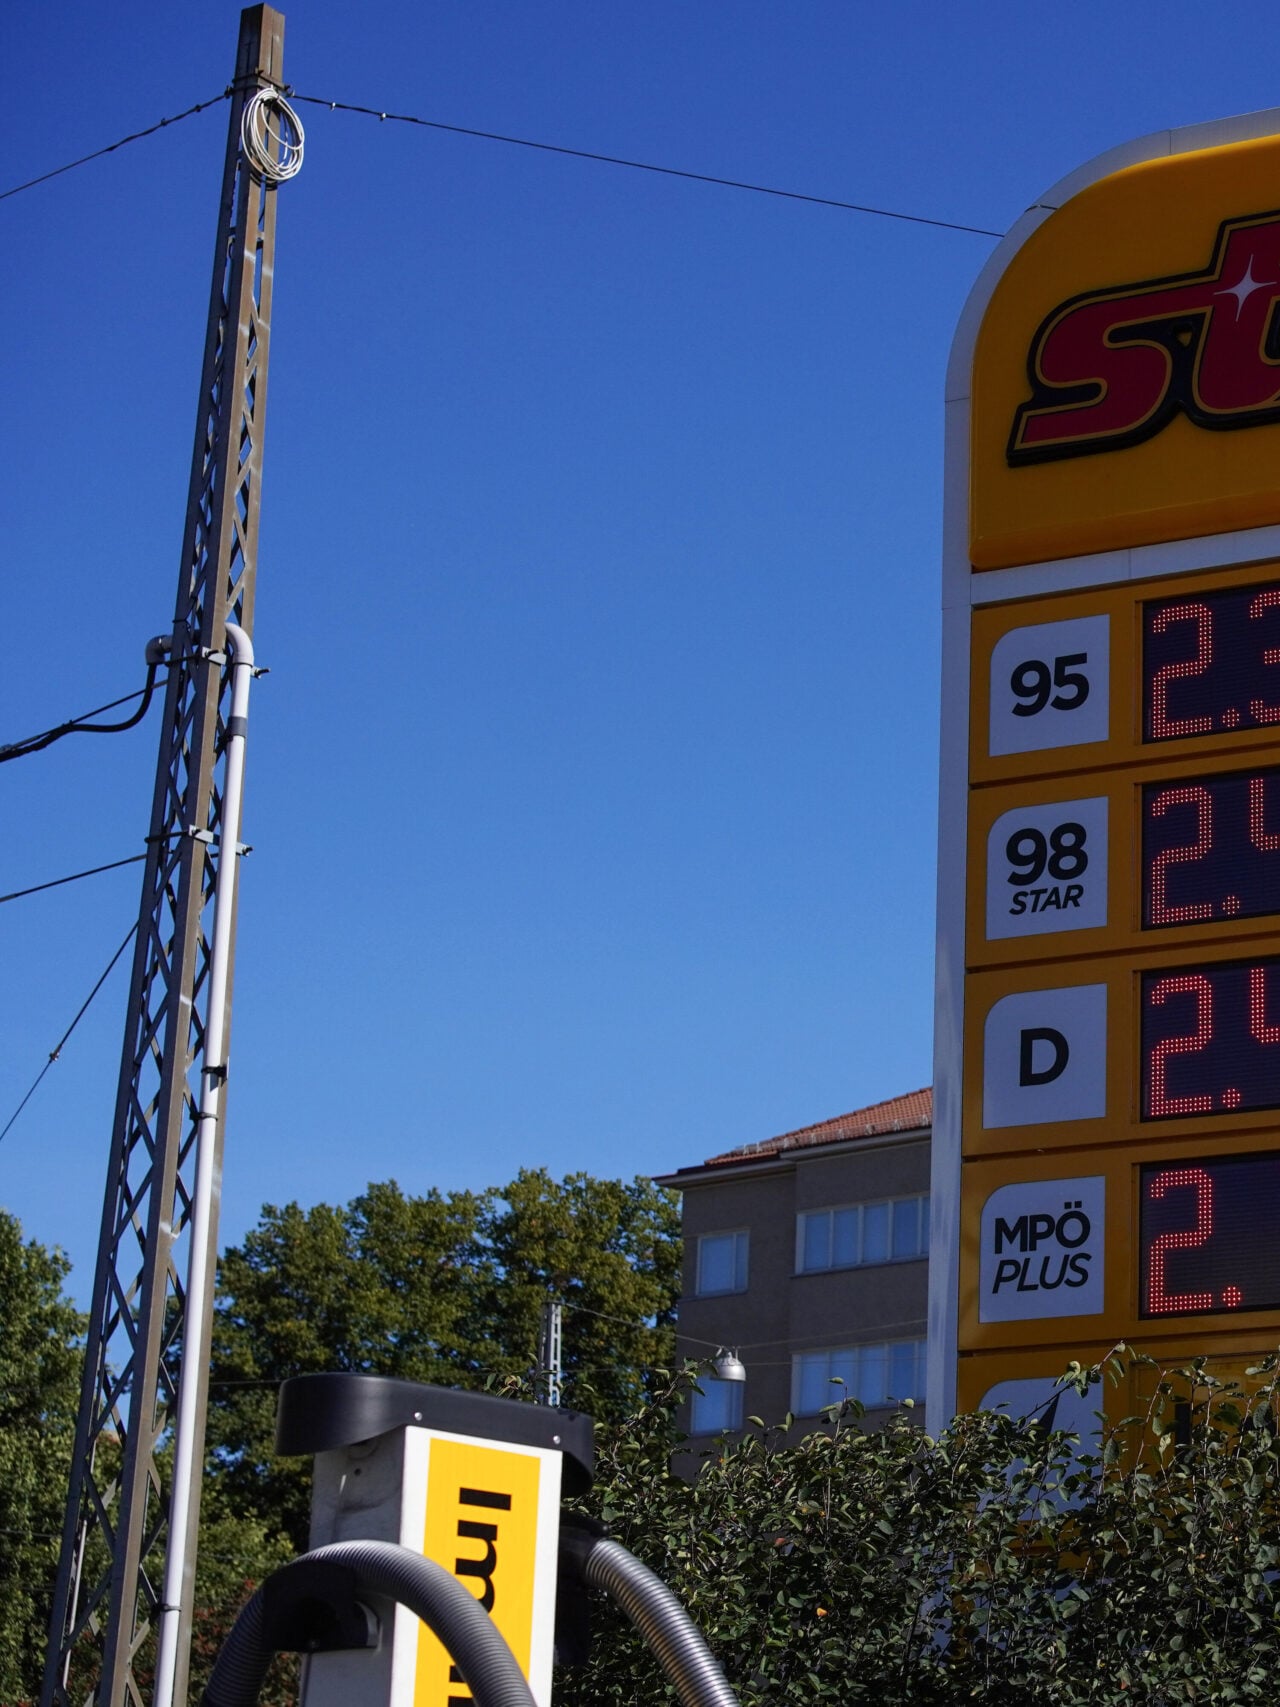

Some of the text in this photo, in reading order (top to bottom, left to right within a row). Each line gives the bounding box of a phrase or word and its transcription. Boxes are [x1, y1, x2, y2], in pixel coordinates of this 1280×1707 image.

[1010, 652, 1090, 717] 95
[1006, 822, 1089, 887] 98
[1008, 884, 1084, 916] STAR
[1018, 1026, 1070, 1088] D
[994, 1200, 1091, 1255] MPÖ
[992, 1252, 1093, 1295] PLUS
